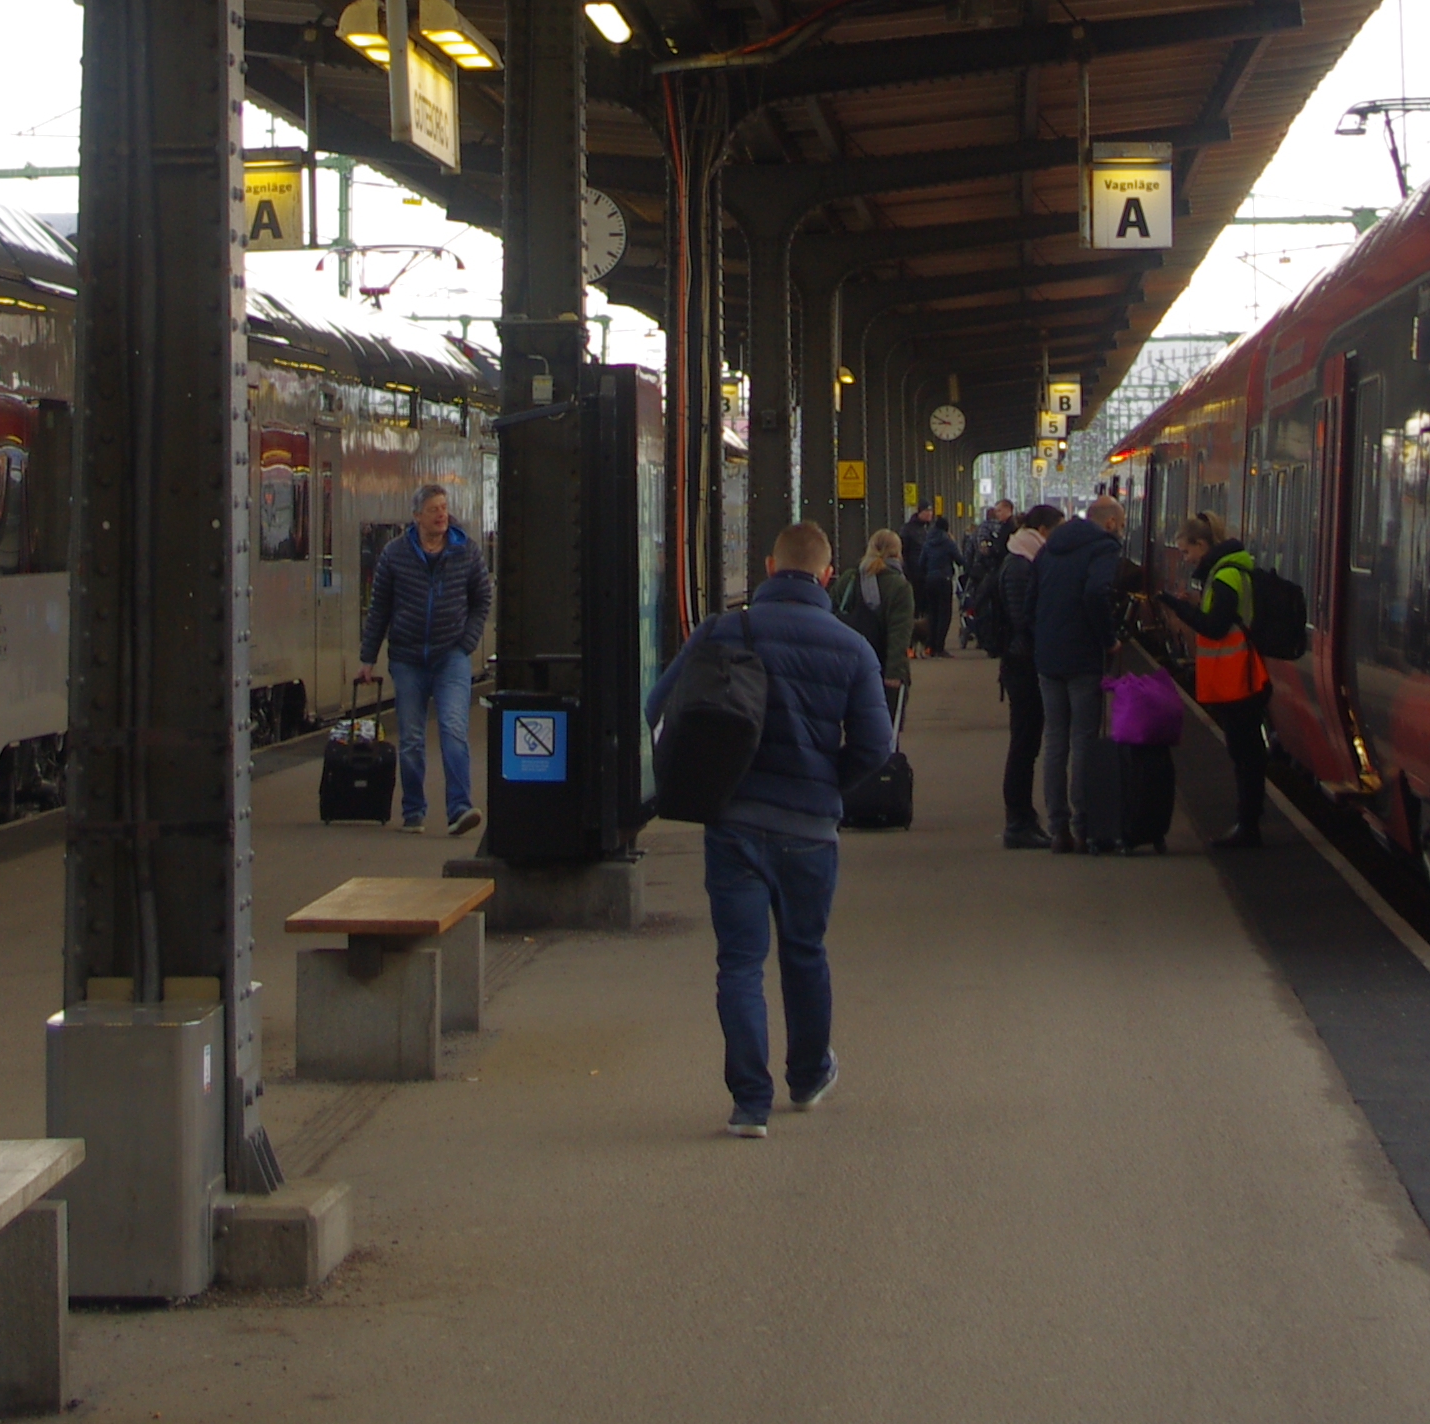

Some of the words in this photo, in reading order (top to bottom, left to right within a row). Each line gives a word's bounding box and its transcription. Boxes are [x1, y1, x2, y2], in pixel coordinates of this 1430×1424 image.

[245, 182, 292, 195] agnläge
[1104, 178, 1160, 192] Vagnläge
[249, 199, 283, 240] A
[1115, 197, 1151, 238] A
[1059, 395, 1071, 412] B
[1048, 420, 1059, 434] 5
[1043, 446, 1053, 458] C
